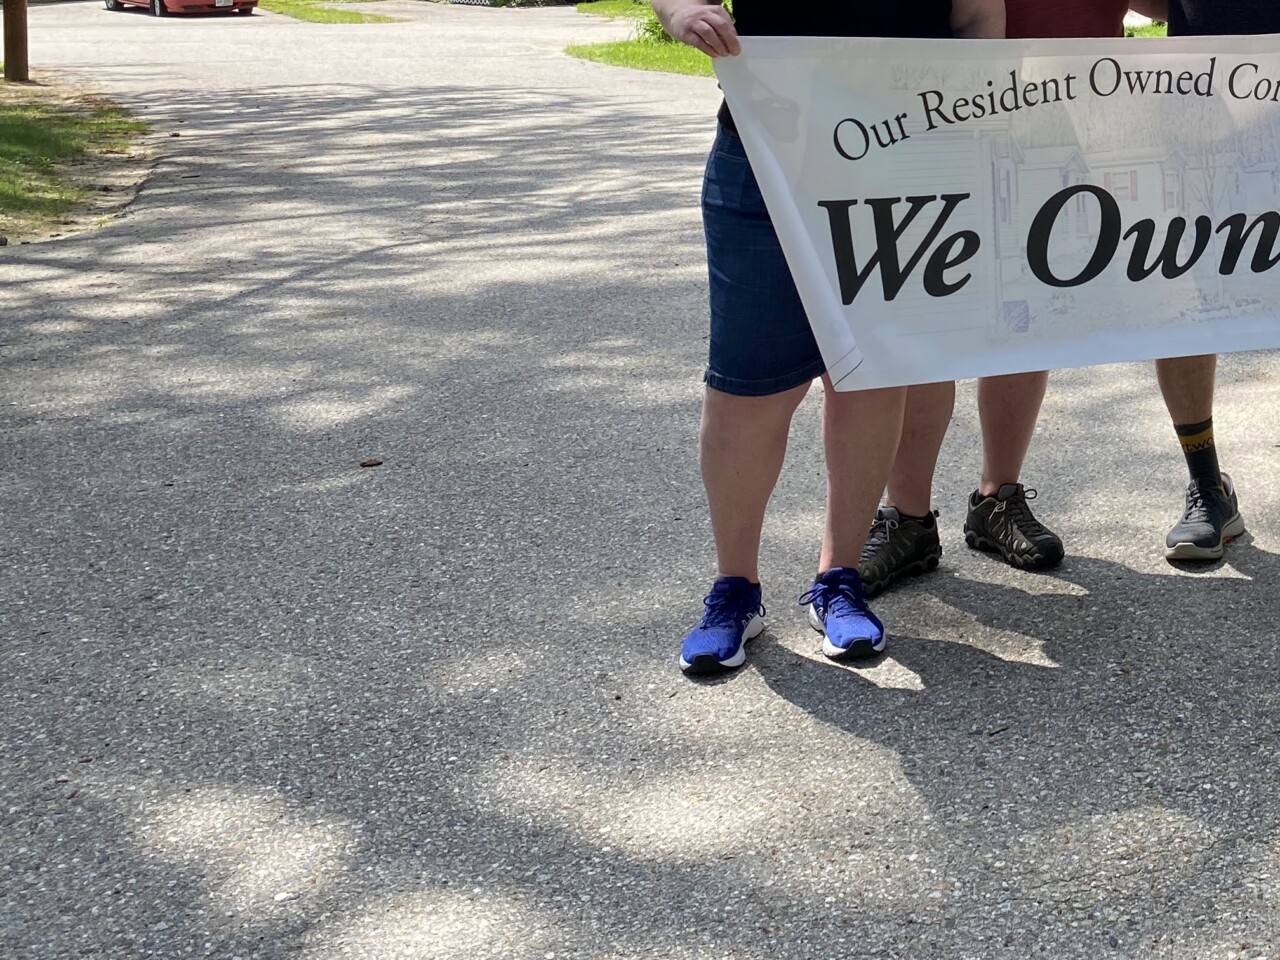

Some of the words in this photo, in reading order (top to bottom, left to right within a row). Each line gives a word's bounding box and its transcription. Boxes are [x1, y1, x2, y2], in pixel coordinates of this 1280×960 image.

[833, 117, 912, 161] Our
[917, 69, 1078, 132] Resident
[1089, 56, 1216, 98] Owned
[816, 192, 981, 306] We
